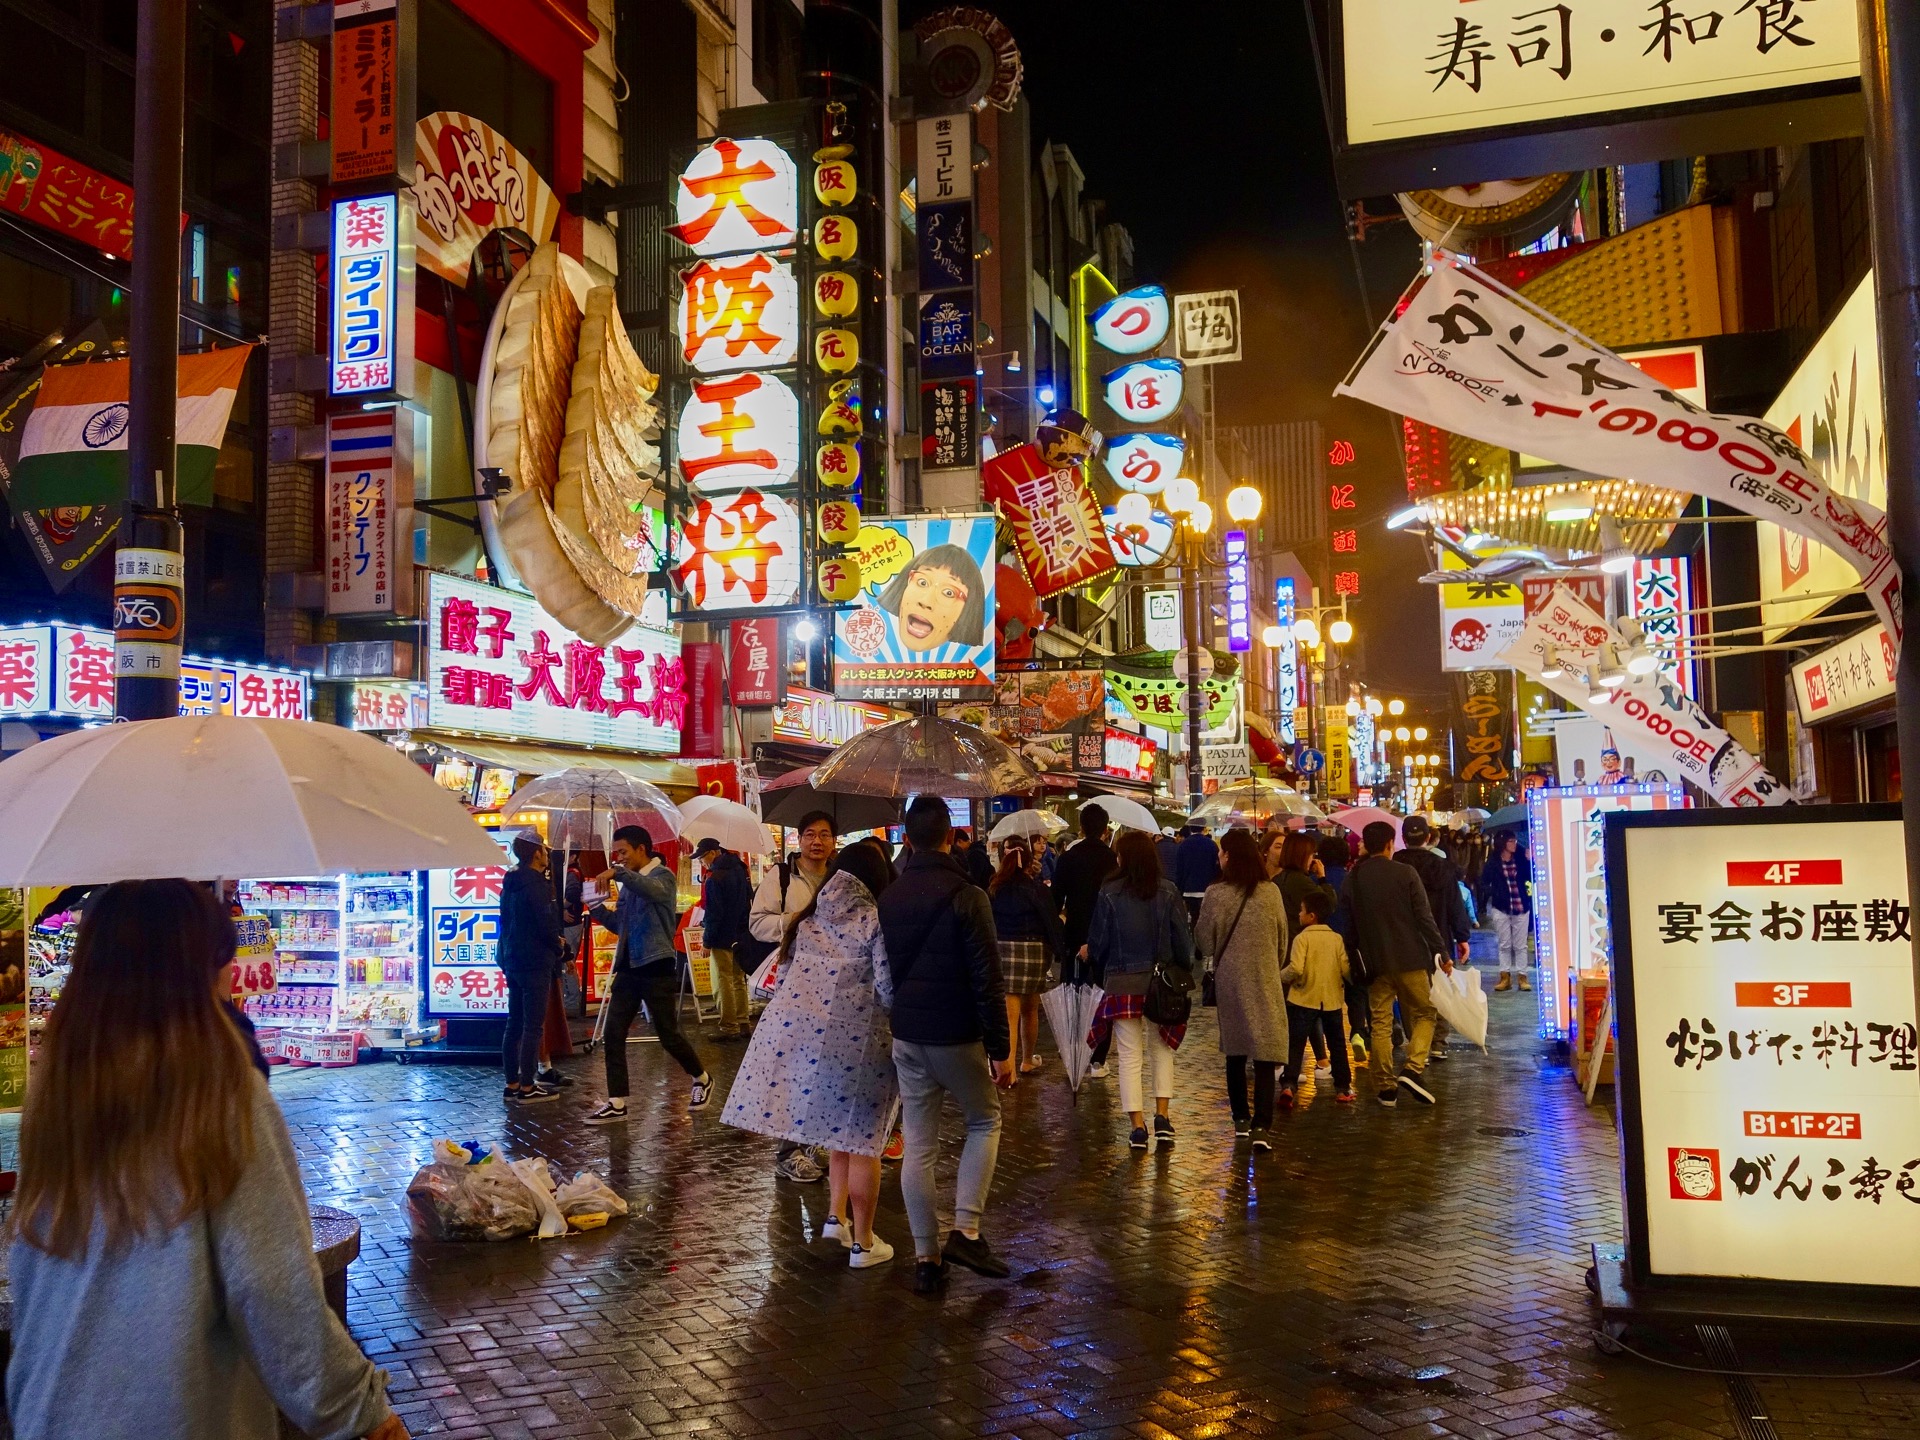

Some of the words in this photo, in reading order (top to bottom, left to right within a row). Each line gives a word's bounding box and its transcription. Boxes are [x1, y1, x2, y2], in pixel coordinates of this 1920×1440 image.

[354, 29, 376, 150] ミティラー
[410, 129, 525, 244] あっぱれ
[346, 206, 386, 249] 薬
[345, 256, 384, 358] ダイコク
[932, 323, 962, 337] BAR
[1186, 311, 1236, 343] 牛角
[922, 342, 973, 356] OCEAN
[335, 364, 390, 390] 免税
[664, 139, 794, 609] 大阪王将
[354, 472, 371, 576] クンテープ
[1017, 483, 1067, 573] ミュージアム
[847, 536, 899, 563] みやげ
[375, 594, 386, 604] B1
[441, 596, 516, 658] 餃子
[1500, 618, 1525, 628] Japa
[69, 645, 116, 708] 薬
[513, 629, 690, 732] 大阪王将
[239, 673, 303, 721] 免税
[1133, 690, 1222, 714] づぼや
[1461, 694, 1509, 781] らーめん
[1207, 764, 1247, 776] PIZZA
[1333, 744, 1343, 779] 一番搾り
[1764, 864, 1801, 884] 4F
[1657, 898, 1911, 945] 宴会お座敷
[231, 962, 275, 994] 248
[1773, 985, 1809, 1005] 3F
[284, 1044, 302, 1058] 198
[317, 1049, 331, 1057] 178
[337, 1049, 351, 1057] 168
[2, 1079, 23, 1096] 2F
